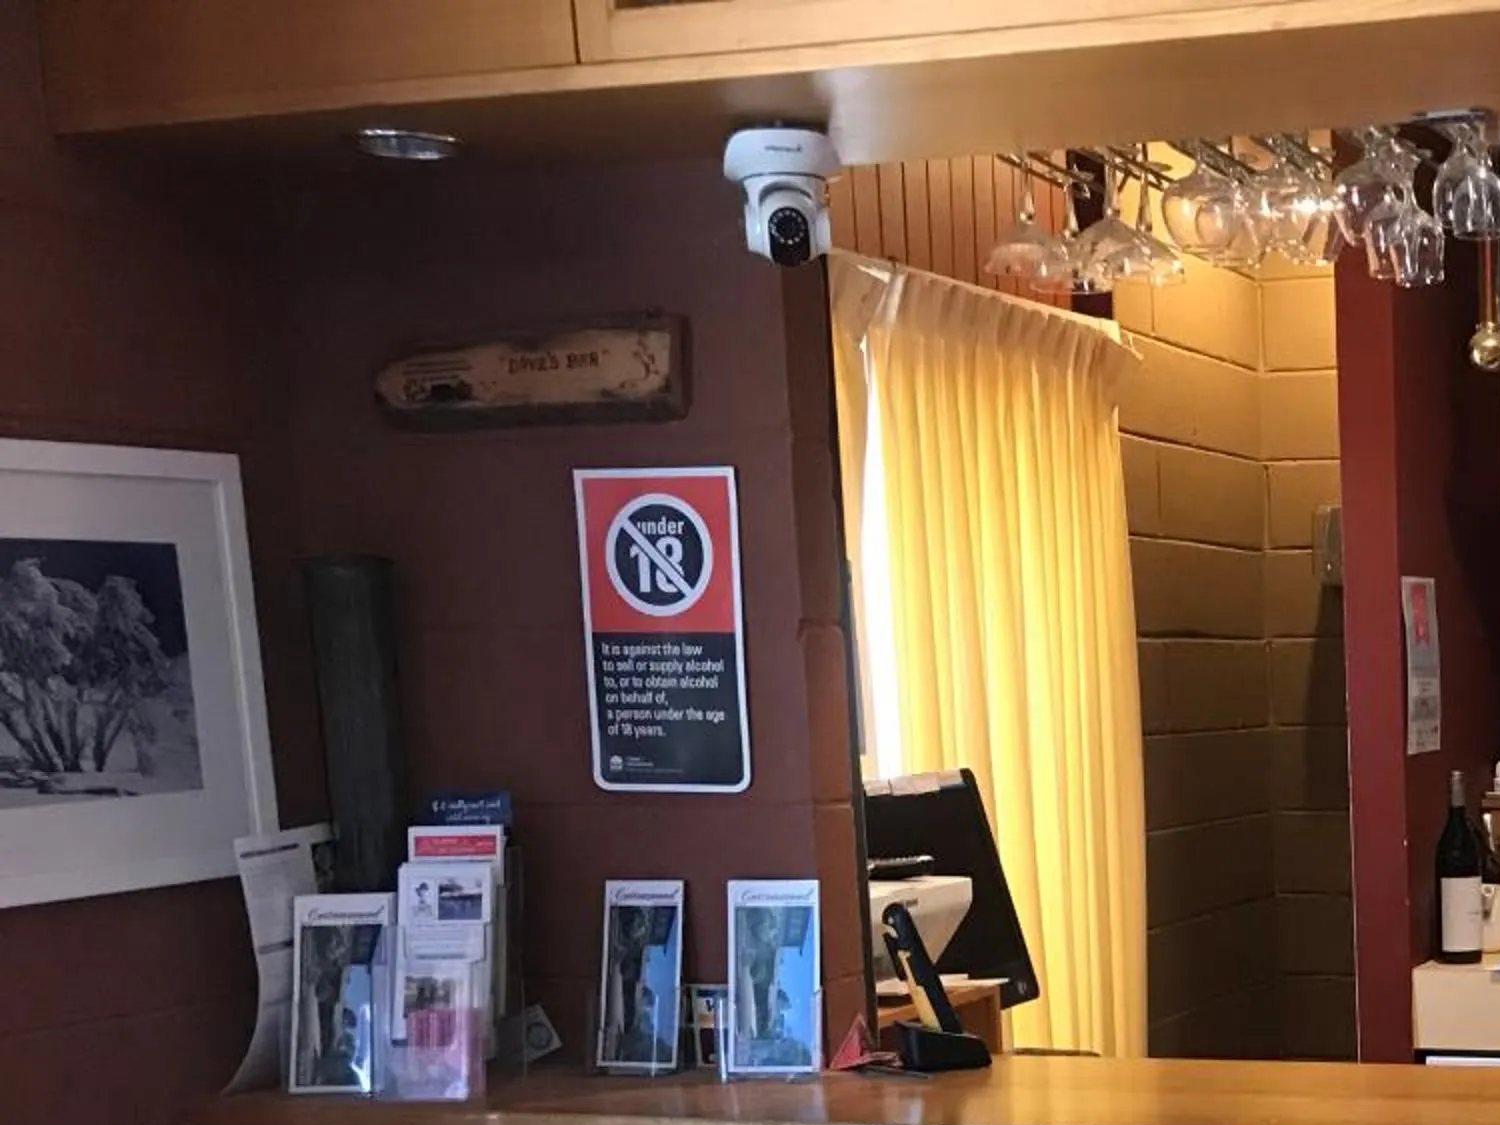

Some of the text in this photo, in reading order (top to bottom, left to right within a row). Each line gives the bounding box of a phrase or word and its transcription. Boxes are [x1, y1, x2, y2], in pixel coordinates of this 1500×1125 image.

[637, 515, 684, 535] under
[629, 536, 685, 593] 18
[623, 643, 661, 658] against
[662, 642, 681, 656] the
[682, 642, 703, 656] law
[603, 658, 725, 675] to sell or supply alcohol
[632, 675, 643, 688] to
[645, 674, 678, 688] obtain
[679, 674, 719, 689] alcohol
[606, 692, 619, 705] on
[620, 690, 653, 705] behalf
[615, 708, 652, 723] person
[653, 707, 684, 721] under
[686, 706, 703, 721] the
[705, 709, 725, 724] age
[607, 722, 619, 736] of
[621, 722, 633, 736] 18
